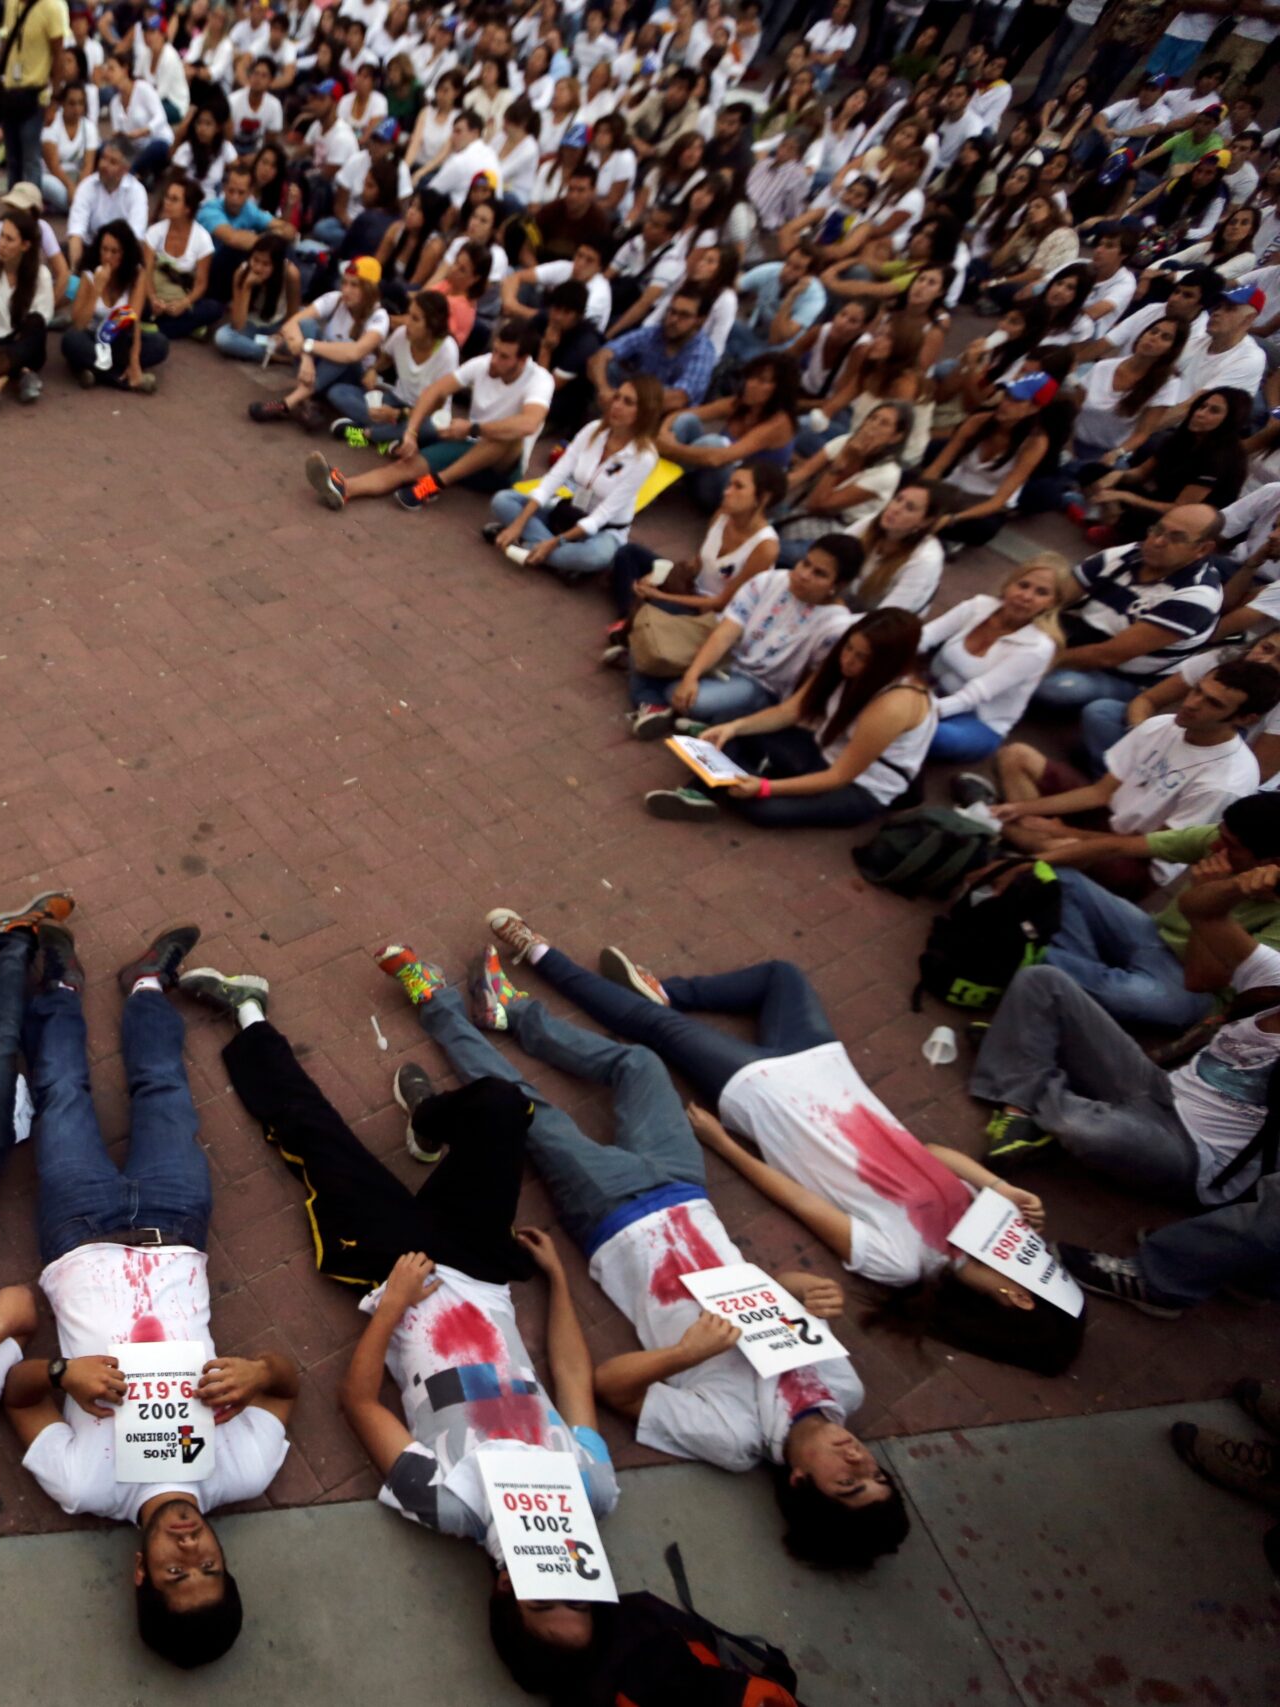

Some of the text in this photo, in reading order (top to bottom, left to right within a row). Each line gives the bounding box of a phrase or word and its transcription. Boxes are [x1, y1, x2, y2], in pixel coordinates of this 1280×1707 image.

[991, 1218, 1029, 1261] 5.868
[1016, 1235, 1042, 1266] 1999
[716, 1290, 777, 1314] 8.022
[738, 1306, 785, 1324] 2000
[779, 1317, 823, 1345] 2
[127, 1381, 193, 1400] 9.617
[138, 1403, 189, 1420] 2002
[125, 1432, 176, 1442] GOBIERNO
[143, 1426, 205, 1464] 4 AÑOS
[503, 1493, 572, 1512] 7.960
[519, 1515, 572, 1533] 2001
[513, 1545, 567, 1555] GOBIERNO
[537, 1539, 600, 1581] 3 AÑOS
